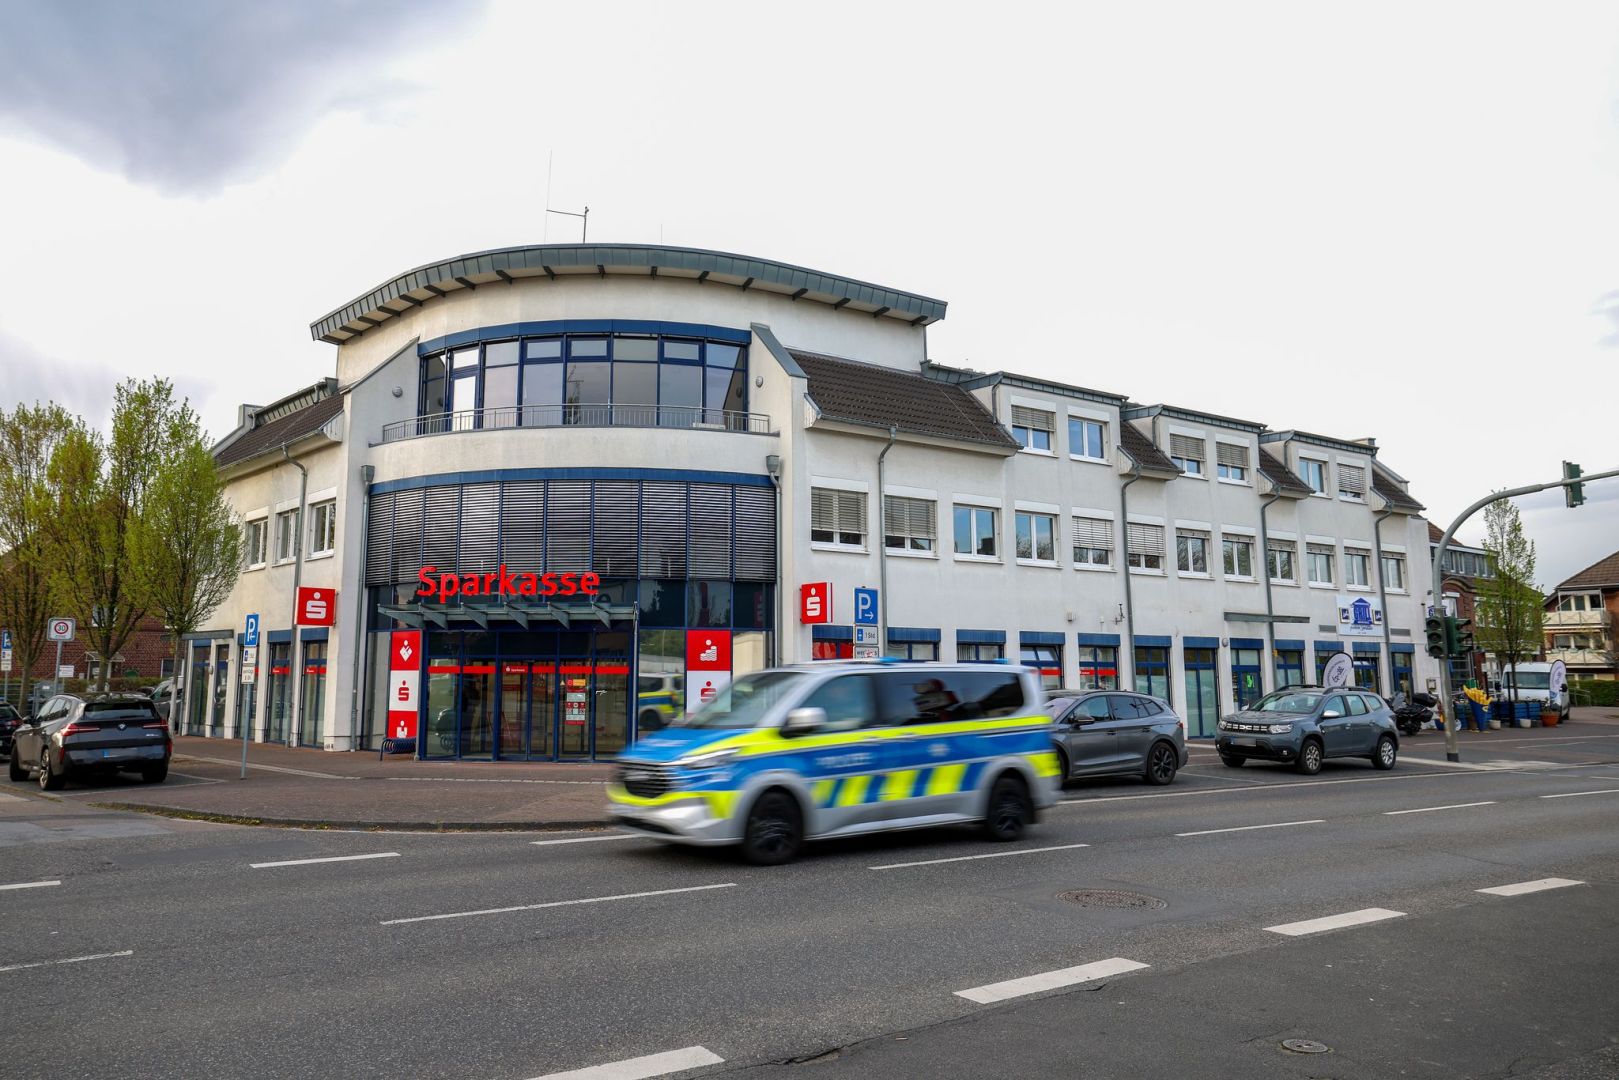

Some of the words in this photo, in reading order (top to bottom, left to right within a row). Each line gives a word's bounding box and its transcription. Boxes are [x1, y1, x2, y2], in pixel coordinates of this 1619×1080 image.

[416, 563, 600, 604] Sparkasse
[858, 592, 872, 620] P
[57, 624, 66, 632] 30
[246, 618, 256, 642] P
